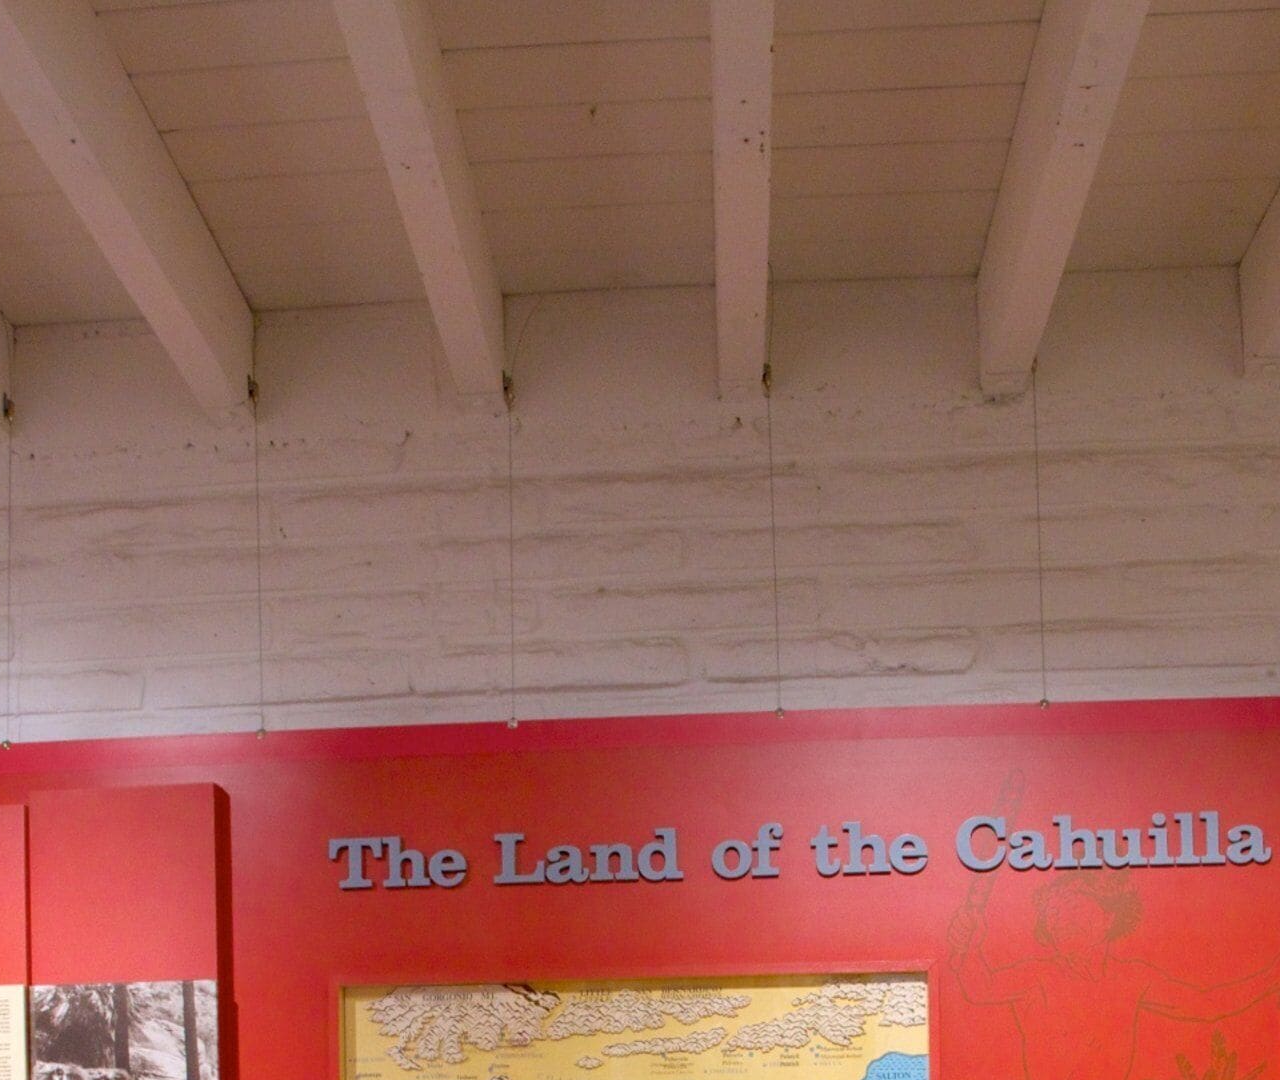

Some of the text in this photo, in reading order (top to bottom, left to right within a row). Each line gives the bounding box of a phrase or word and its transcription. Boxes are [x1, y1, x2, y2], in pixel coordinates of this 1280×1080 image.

[329, 811, 1272, 890] The Land of the Cahuilla
[875, 1072, 911, 1080] SALTON
